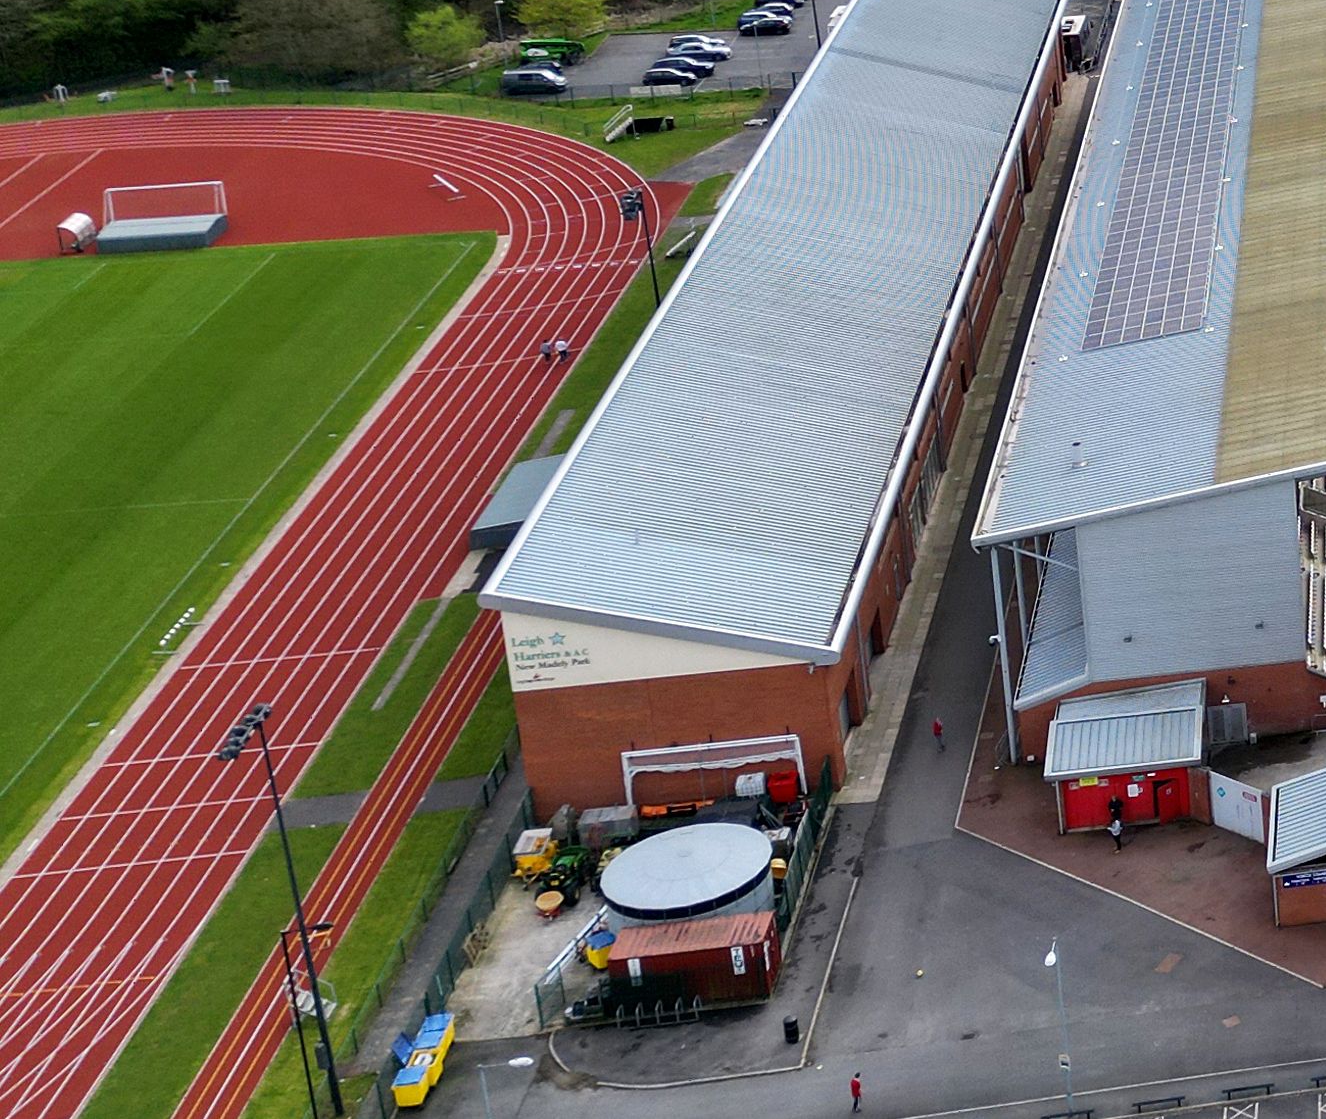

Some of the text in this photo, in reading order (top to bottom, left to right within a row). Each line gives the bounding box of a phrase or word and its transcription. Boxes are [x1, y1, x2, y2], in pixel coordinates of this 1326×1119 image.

[511, 636, 544, 648] Leigh
[513, 651, 561, 661] Harriers
[571, 657, 591, 666] Park
